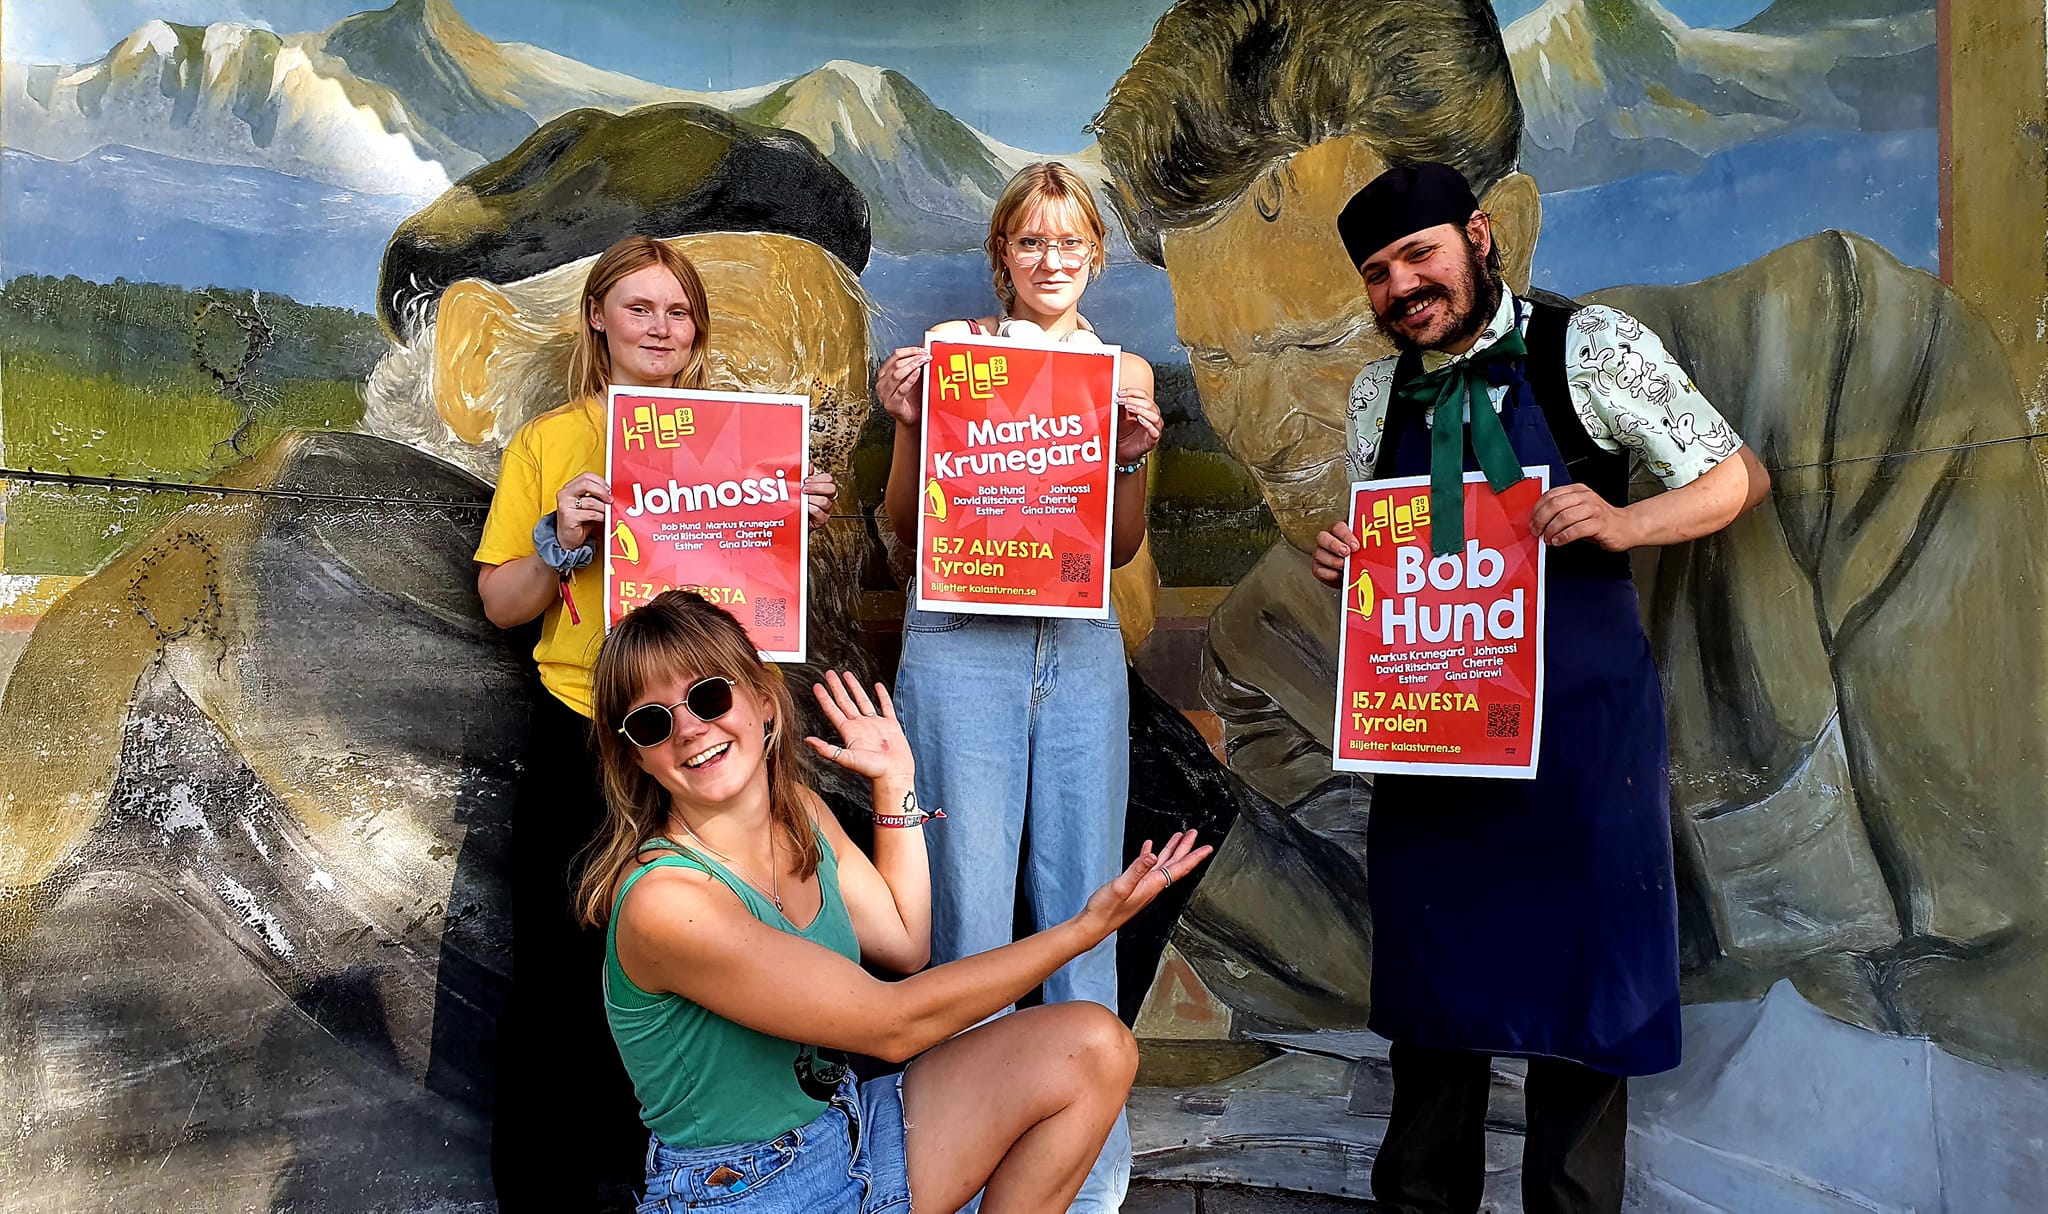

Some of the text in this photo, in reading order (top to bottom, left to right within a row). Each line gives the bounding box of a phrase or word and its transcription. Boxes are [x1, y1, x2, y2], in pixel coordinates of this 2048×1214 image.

[967, 414, 1083, 448] Markus
[933, 435, 1102, 479] Krunegård
[625, 469, 789, 517] Johnossi
[978, 483, 1090, 495] Bob Hund Johnossi
[953, 495, 1077, 505] David Ritschard Cherrie
[976, 505, 1076, 515] Esther Gina Dirawi
[653, 529, 773, 541] David Ritschard Cherrie
[661, 522, 678, 531] Bob
[680, 522, 701, 531] Hund
[706, 521, 738, 530] Markus
[675, 539, 772, 551] Esther Gina Dirawi
[932, 536, 1054, 560] 15.7 ALVESTA
[932, 556, 1004, 578] Tyrolen
[1397, 539, 1505, 594] Bob
[662, 585, 747, 604] ESTA
[931, 582, 1037, 596] Biljetter kalasturnen.se
[1382, 589, 1524, 645] Hund
[1369, 652, 1408, 664] Markus
[1473, 643, 1517, 656] Johnossi
[1376, 656, 1504, 675] David Ritschard Cherrie
[1399, 668, 1502, 684] Esther Gina Dirawi
[1352, 691, 1480, 712] 15.7 ALVESTA
[1352, 712, 1427, 735] Tyrolen
[1350, 740, 1461, 753] Biljetter kalasturnen.se
